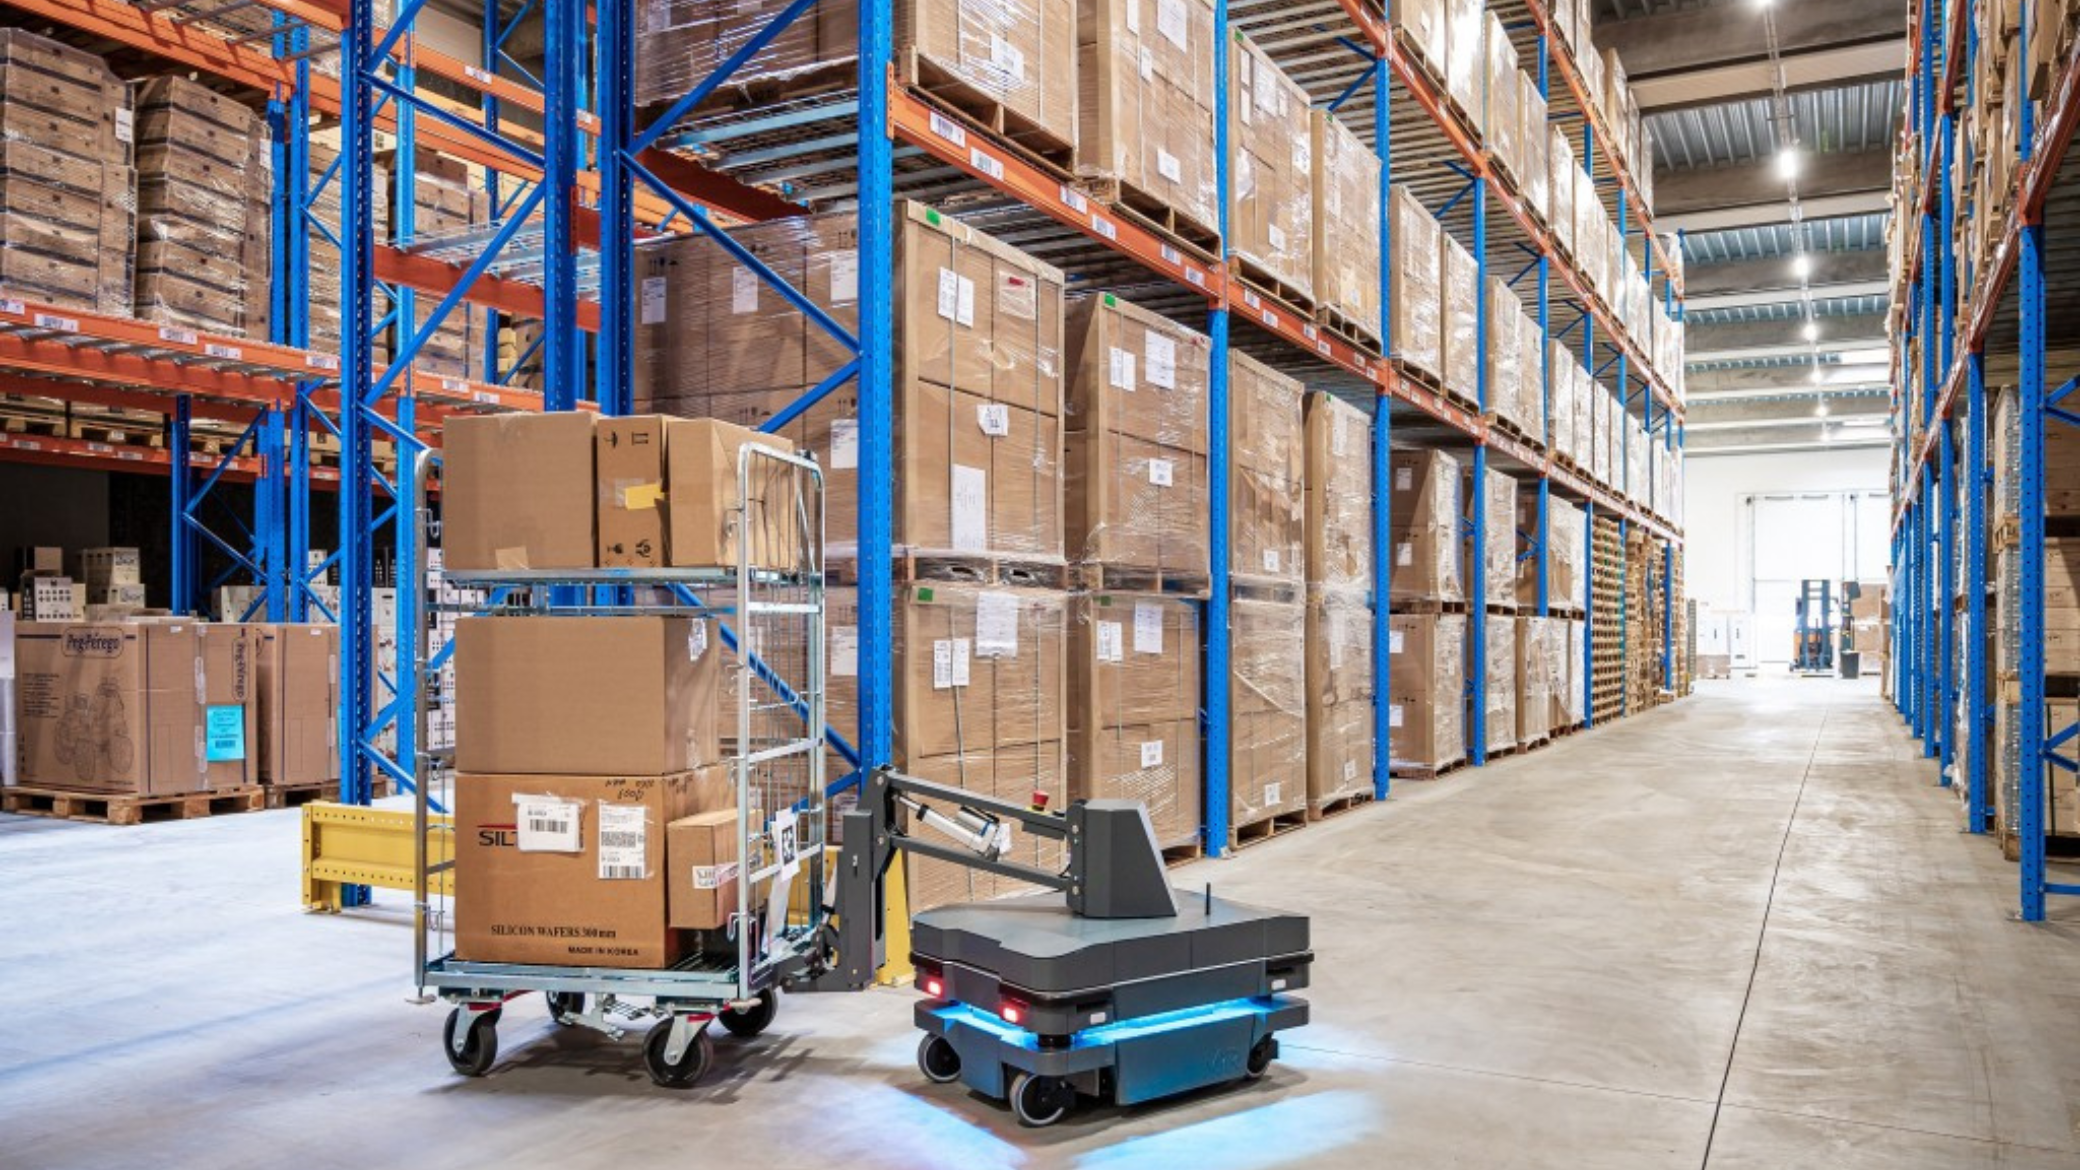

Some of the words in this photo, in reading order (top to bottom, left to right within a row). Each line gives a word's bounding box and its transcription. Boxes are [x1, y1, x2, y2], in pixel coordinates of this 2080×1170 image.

[490, 924, 535, 937] SILICON
[536, 926, 580, 938] WAFERS
[568, 946, 593, 954] MADE
[594, 947, 605, 955] IN
[606, 947, 639, 957] KOREA
